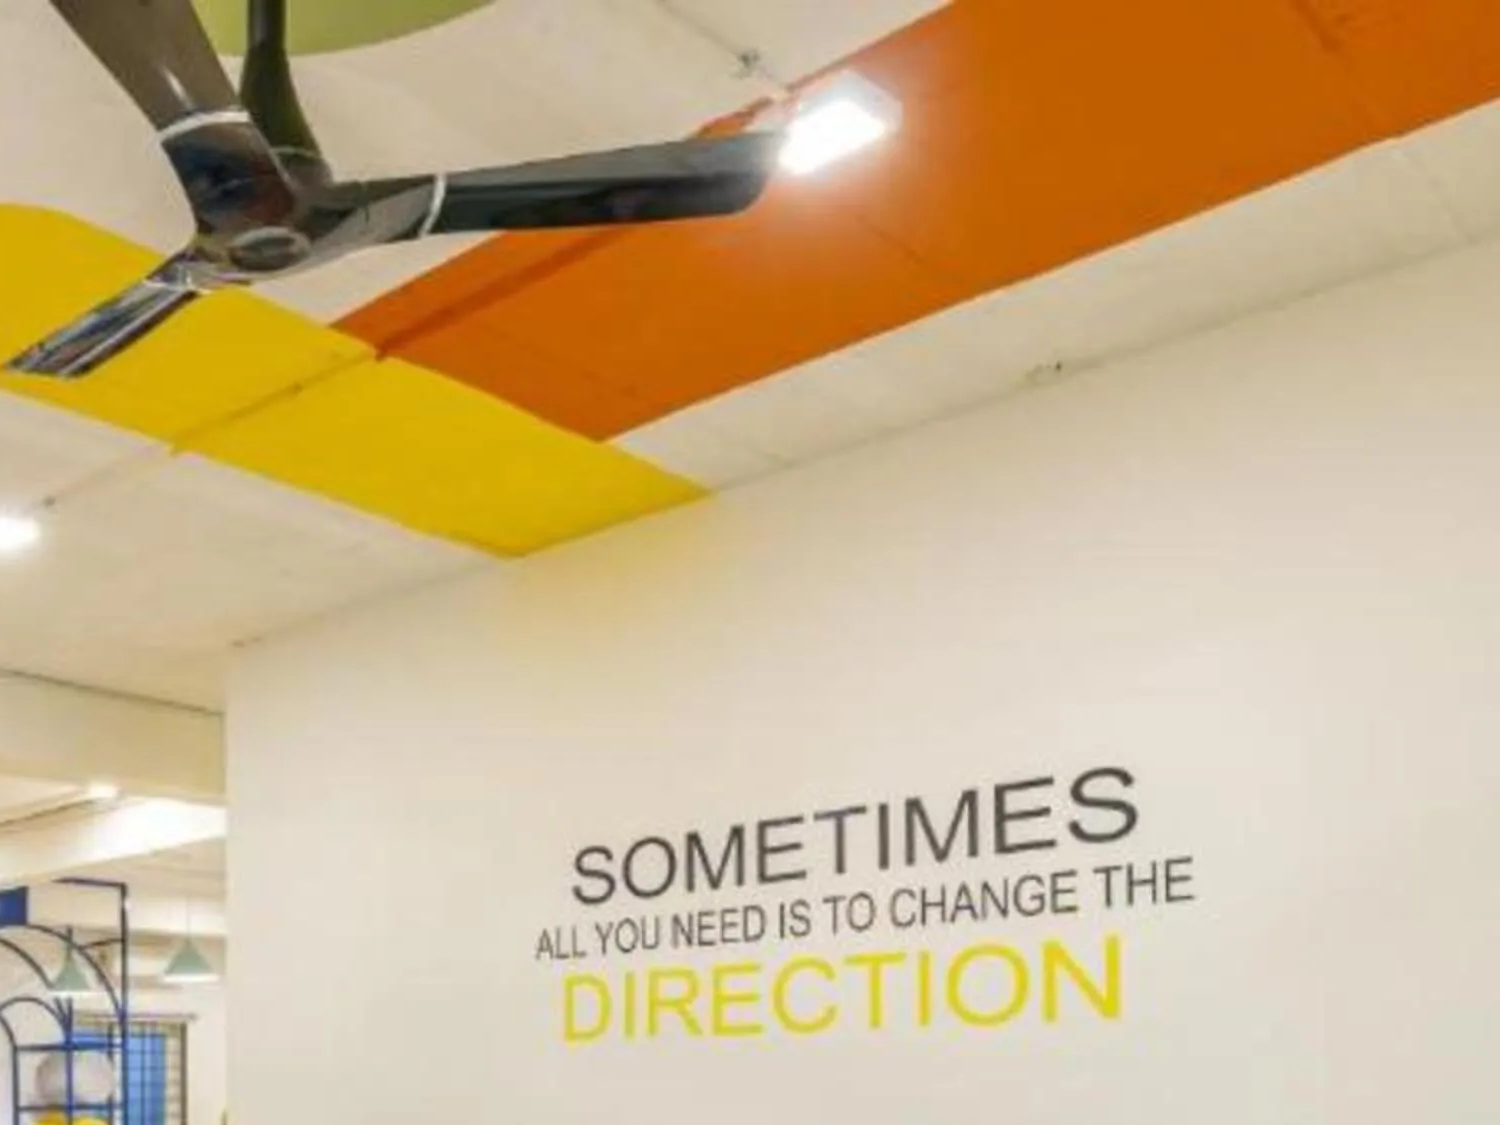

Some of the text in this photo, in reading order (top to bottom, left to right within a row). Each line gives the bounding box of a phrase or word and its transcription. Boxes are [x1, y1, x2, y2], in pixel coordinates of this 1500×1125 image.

[570, 766, 1139, 905] SOMETIMES
[535, 855, 1196, 961] ALL YOU NEED IS TO CHANGE THE
[562, 933, 1123, 1043] DIRECTION
